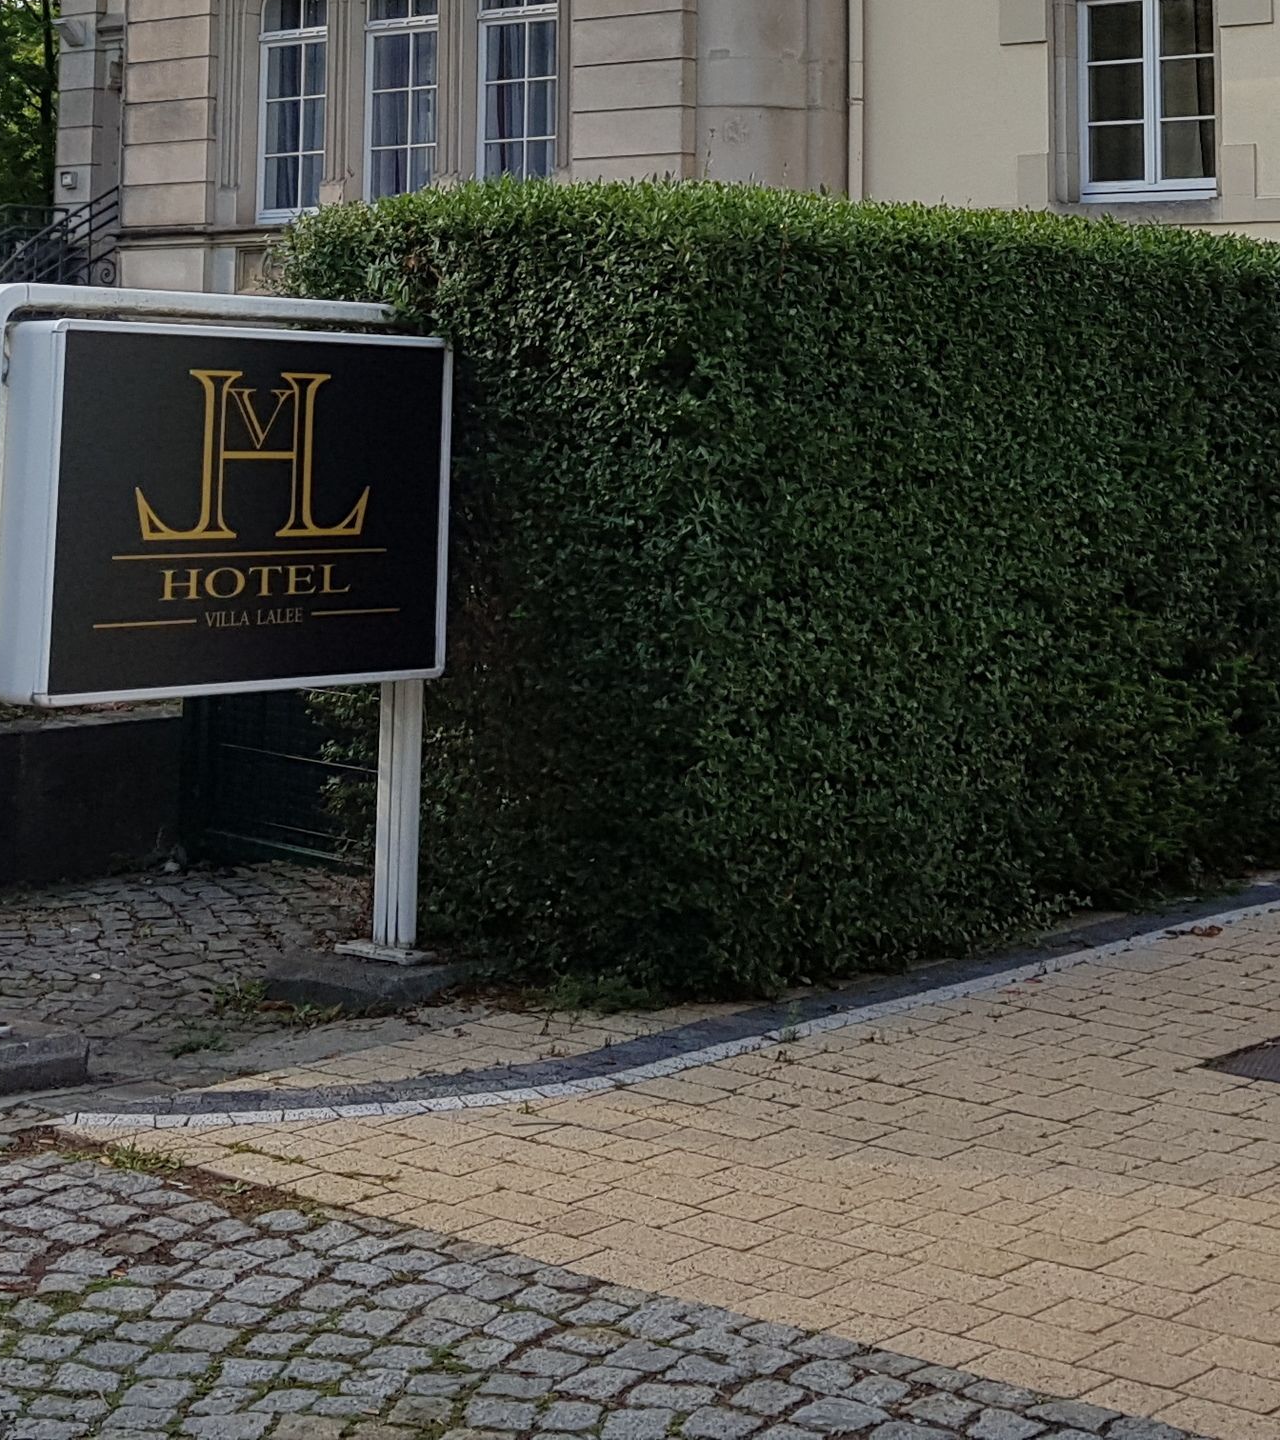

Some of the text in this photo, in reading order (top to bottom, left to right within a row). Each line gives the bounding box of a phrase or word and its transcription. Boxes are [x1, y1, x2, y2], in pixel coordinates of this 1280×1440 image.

[158, 563, 351, 602] HOTEL
[205, 607, 304, 628] VILLA LALEE
